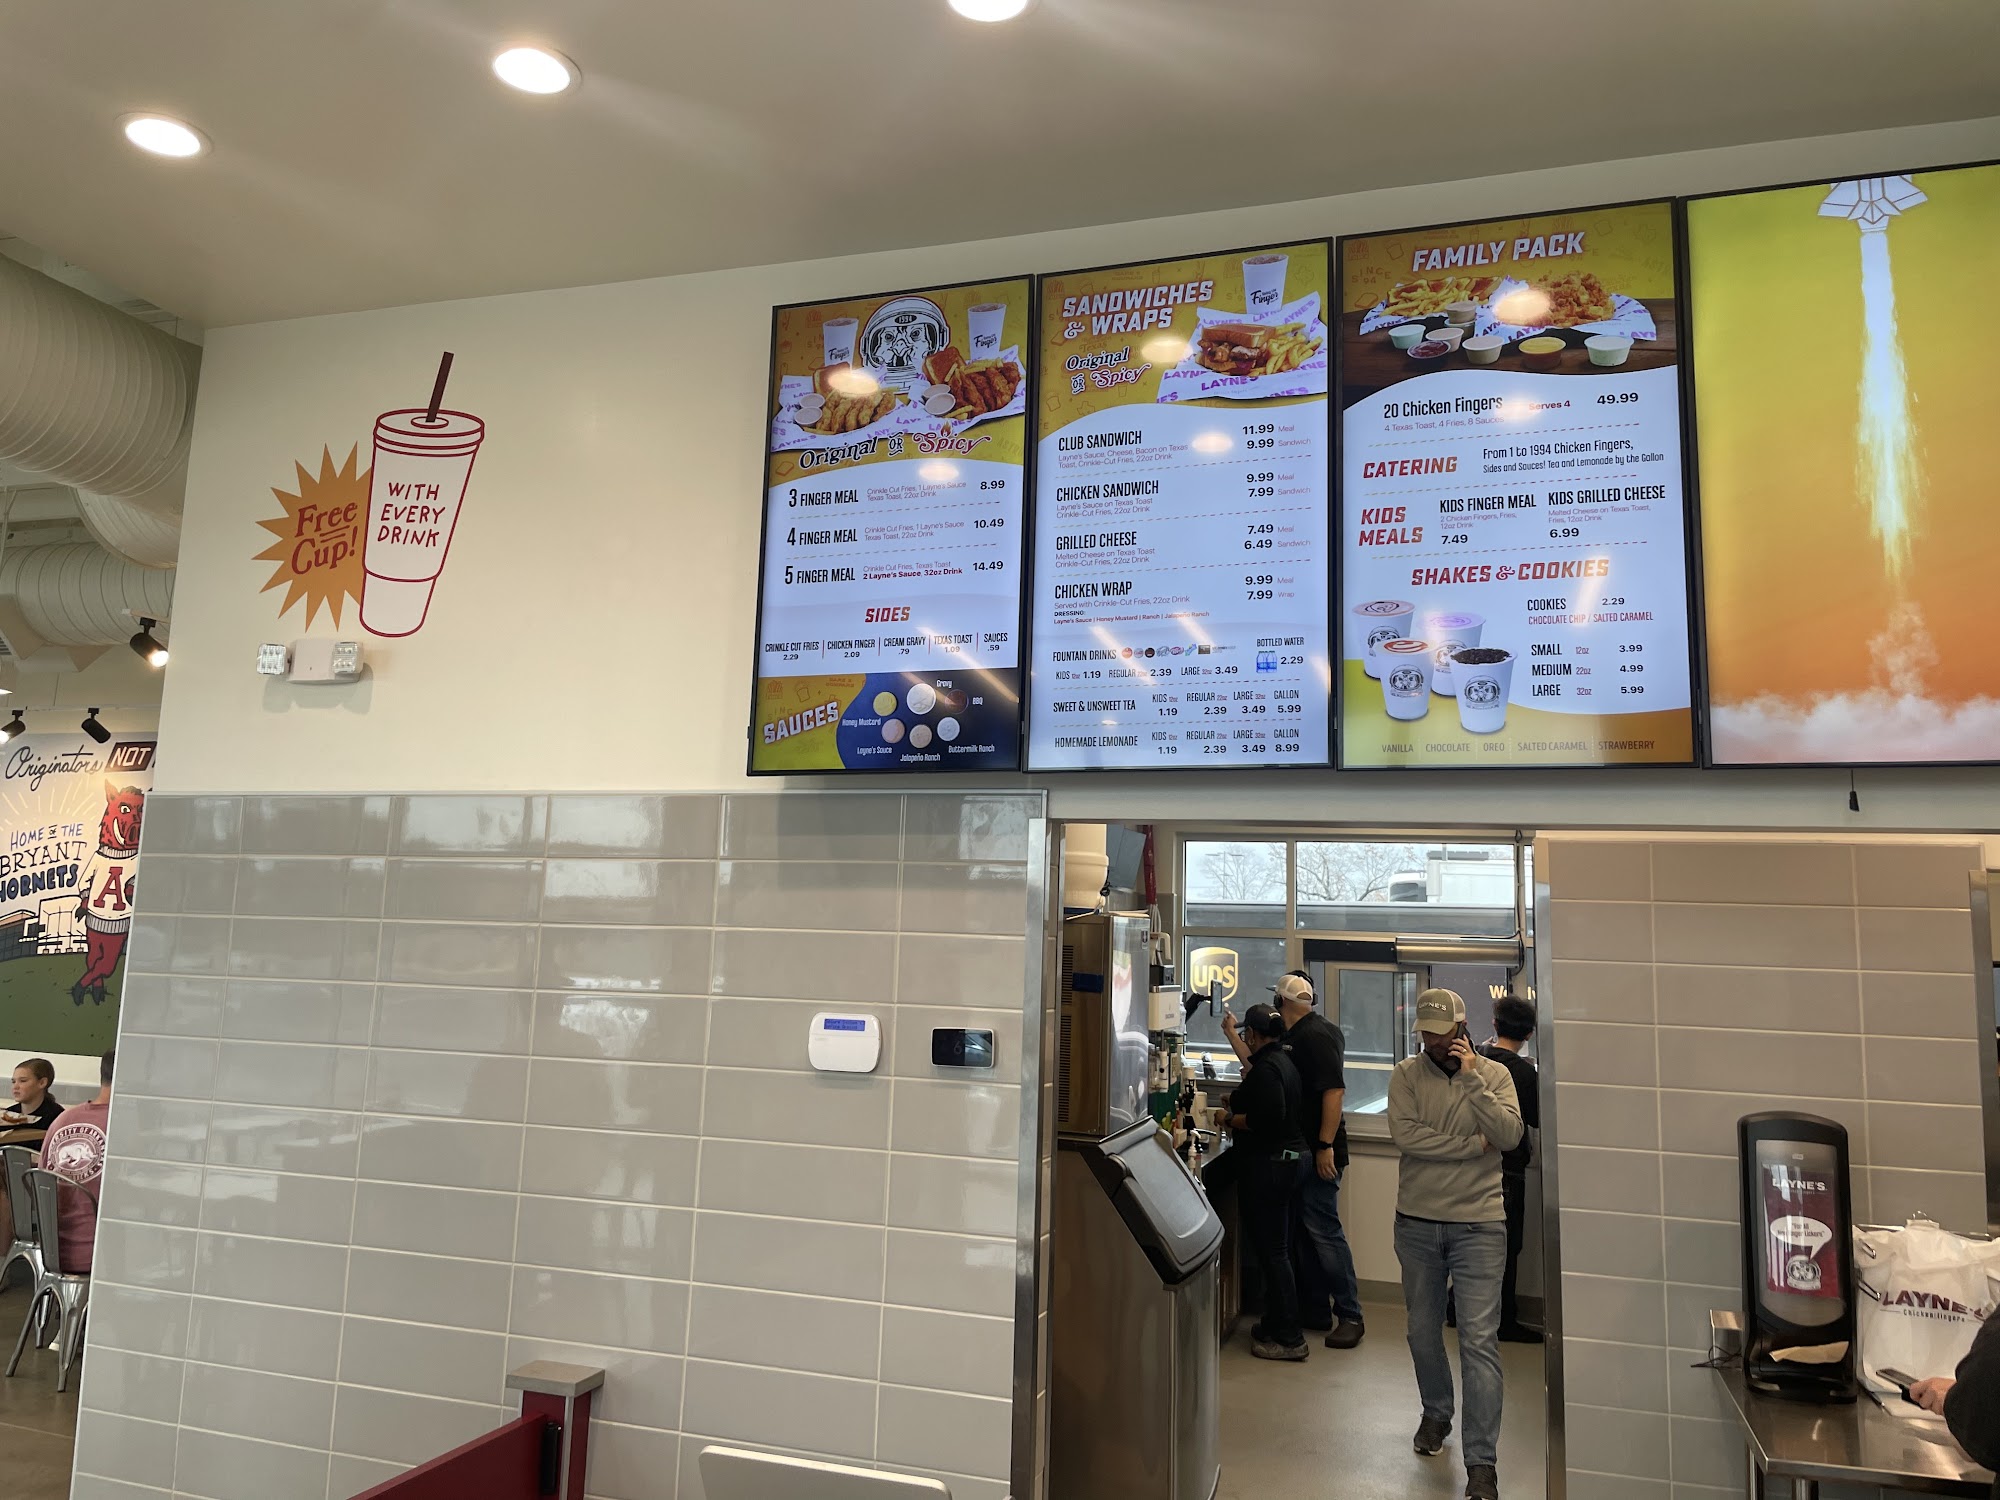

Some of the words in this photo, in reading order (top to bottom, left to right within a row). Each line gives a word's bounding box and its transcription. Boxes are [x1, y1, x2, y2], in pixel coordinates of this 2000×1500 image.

[1412, 242, 1505, 272] FAMILY
[1513, 232, 1584, 261] PACK
[1062, 280, 1213, 317] SANDWICHES
[1064, 321, 1085, 338] &
[1092, 308, 1172, 335] WRAPS
[1066, 347, 1128, 370] Original
[1072, 374, 1084, 394] OR
[1091, 364, 1151, 387] Spicy
[1384, 403, 1398, 419] 20
[1403, 399, 1452, 417] Chicken
[1455, 396, 1502, 414] Fingers
[1597, 393, 1638, 405] 49.99
[1059, 436, 1083, 451] CLUB
[1087, 431, 1142, 449] SANDWICH
[1242, 424, 1274, 435] 11.99
[1247, 439, 1274, 449] 9.99
[800, 436, 877, 468] Original
[889, 432, 903, 457] OR
[913, 432, 991, 454] Spicy
[1483, 448, 1507, 460] From
[1510, 447, 1513, 458] 1
[1516, 446, 1527, 457] to
[1530, 444, 1551, 456] 1994
[1554, 442, 1591, 455] Chicken
[1595, 440, 1634, 453] Fingers,
[1363, 457, 1458, 478] CATERING
[389, 482, 439, 500] WITH
[789, 488, 797, 507] 3
[800, 492, 831, 506] FINGER
[835, 490, 858, 503] MEAL
[980, 480, 1005, 490] 8.99
[1057, 485, 1100, 501] CHICKEN
[1103, 480, 1159, 498] SANDWICH
[1246, 472, 1274, 483] 9.99
[1248, 487, 1274, 497] 7.99
[1440, 498, 1464, 513] KIDS
[1468, 496, 1504, 511] FINGER
[1508, 494, 1536, 508] MEAL
[1549, 491, 1573, 506] KIDS
[1577, 488, 1621, 503] GRILLED
[1625, 486, 1665, 501] CHEESE
[294, 502, 357, 538] Free
[381, 504, 445, 524] EVERY
[1361, 507, 1406, 525] KIDS
[378, 525, 439, 547] DRINK
[787, 527, 796, 545] 4
[799, 530, 831, 545] FINGER
[834, 529, 857, 543] MEAL
[974, 519, 1004, 528] 10.49
[1056, 535, 1096, 550] GRILLED
[1100, 532, 1137, 547] CHEESE
[1247, 525, 1274, 535] 7.49
[1359, 527, 1423, 546] MEALS
[1441, 534, 1468, 544] 7.49
[1549, 528, 1579, 539] 6.99
[292, 526, 358, 575] Cup!
[1244, 539, 1272, 549] 6.49
[785, 566, 793, 584] 5
[797, 569, 828, 584] FINGER
[831, 567, 855, 582] MEAL
[973, 561, 1003, 571] 14.49
[869, 572, 897, 580] Layne's
[943, 568, 962, 576] Drink
[1412, 566, 1491, 586] SHAKES
[1496, 566, 1515, 580] &
[1518, 559, 1609, 581] COOKIES
[1055, 584, 1098, 599] CHICKEN
[1101, 581, 1132, 597] WRAP
[1245, 575, 1273, 585] 9.99
[1247, 590, 1273, 600] 7.99
[1527, 598, 1566, 611] COOKIES
[865, 607, 911, 622] SIDES
[828, 640, 852, 650] CHICKEN
[855, 639, 875, 648] FINGER
[884, 638, 904, 647] CREAM
[907, 636, 926, 646] GRAVY
[934, 635, 952, 644] TEXAS
[954, 634, 972, 644] TOAST
[984, 633, 1008, 642] SAUCES
[1257, 639, 1282, 647] BOTTLED
[1285, 637, 1304, 646] WATER
[765, 642, 789, 652] CRINKLE
[791, 643, 801, 651] CUT
[803, 642, 819, 650] FRIES
[1531, 644, 1562, 656] SMALL
[1053, 651, 1087, 661] FOUNTAIN
[1090, 650, 1116, 660] DRINKS
[1281, 656, 1303, 664] 2.29
[1056, 671, 1070, 679] KIDS
[1083, 670, 1100, 679] 1.19
[1109, 669, 1135, 678] REGULAR
[1150, 669, 1171, 677] 2.39
[1181, 666, 1200, 676] LARGE
[1215, 666, 1238, 674] 3.49
[1532, 664, 1572, 676] MEDIUM
[1620, 665, 1644, 673] 4.99
[937, 680, 952, 688] Gravy
[1533, 685, 1560, 697] LARGE
[1621, 686, 1644, 694] 5.99
[973, 697, 983, 705] BBQ
[1053, 702, 1076, 712] SWEET
[1079, 702, 1085, 711] &
[1087, 701, 1121, 711] UNSWEET
[1123, 700, 1135, 710] TEA
[1158, 708, 1177, 716] 1.19
[1204, 706, 1226, 715] 2.39
[1242, 705, 1265, 714] 3.49
[1278, 705, 1301, 713] 5.99
[764, 701, 838, 744] SAUCES
[842, 719, 857, 727] Honey
[859, 718, 881, 726] Mustard
[949, 744, 977, 753] Buttermilk
[979, 744, 994, 752] Ranch
[1055, 737, 1097, 748] HOMEMADE
[1099, 736, 1138, 746] LEMONADE
[1158, 746, 1177, 754] 1.19
[1203, 745, 1226, 753] 2.39
[1242, 745, 1265, 753] 3.49
[1275, 744, 1299, 752] 8.99
[1382, 744, 1414, 753] VANILLA
[1426, 743, 1470, 752] CHOCOLATE
[1483, 743, 1505, 752] OREO
[1518, 742, 1547, 751] SALTED
[1549, 741, 1587, 751] CARAMEL
[1599, 741, 1654, 750] STRAWBERRY
[857, 746, 875, 755] Layne's
[877, 746, 892, 754] Sauce
[900, 753, 923, 762] Jalapeño
[925, 754, 940, 762] Ranch
[6, 744, 103, 791] Originators
[110, 747, 150, 767] NOT
[11, 827, 44, 851] HOME
[61, 824, 83, 837] THE
[0, 841, 87, 877] BRYANT
[94, 866, 126, 910] A
